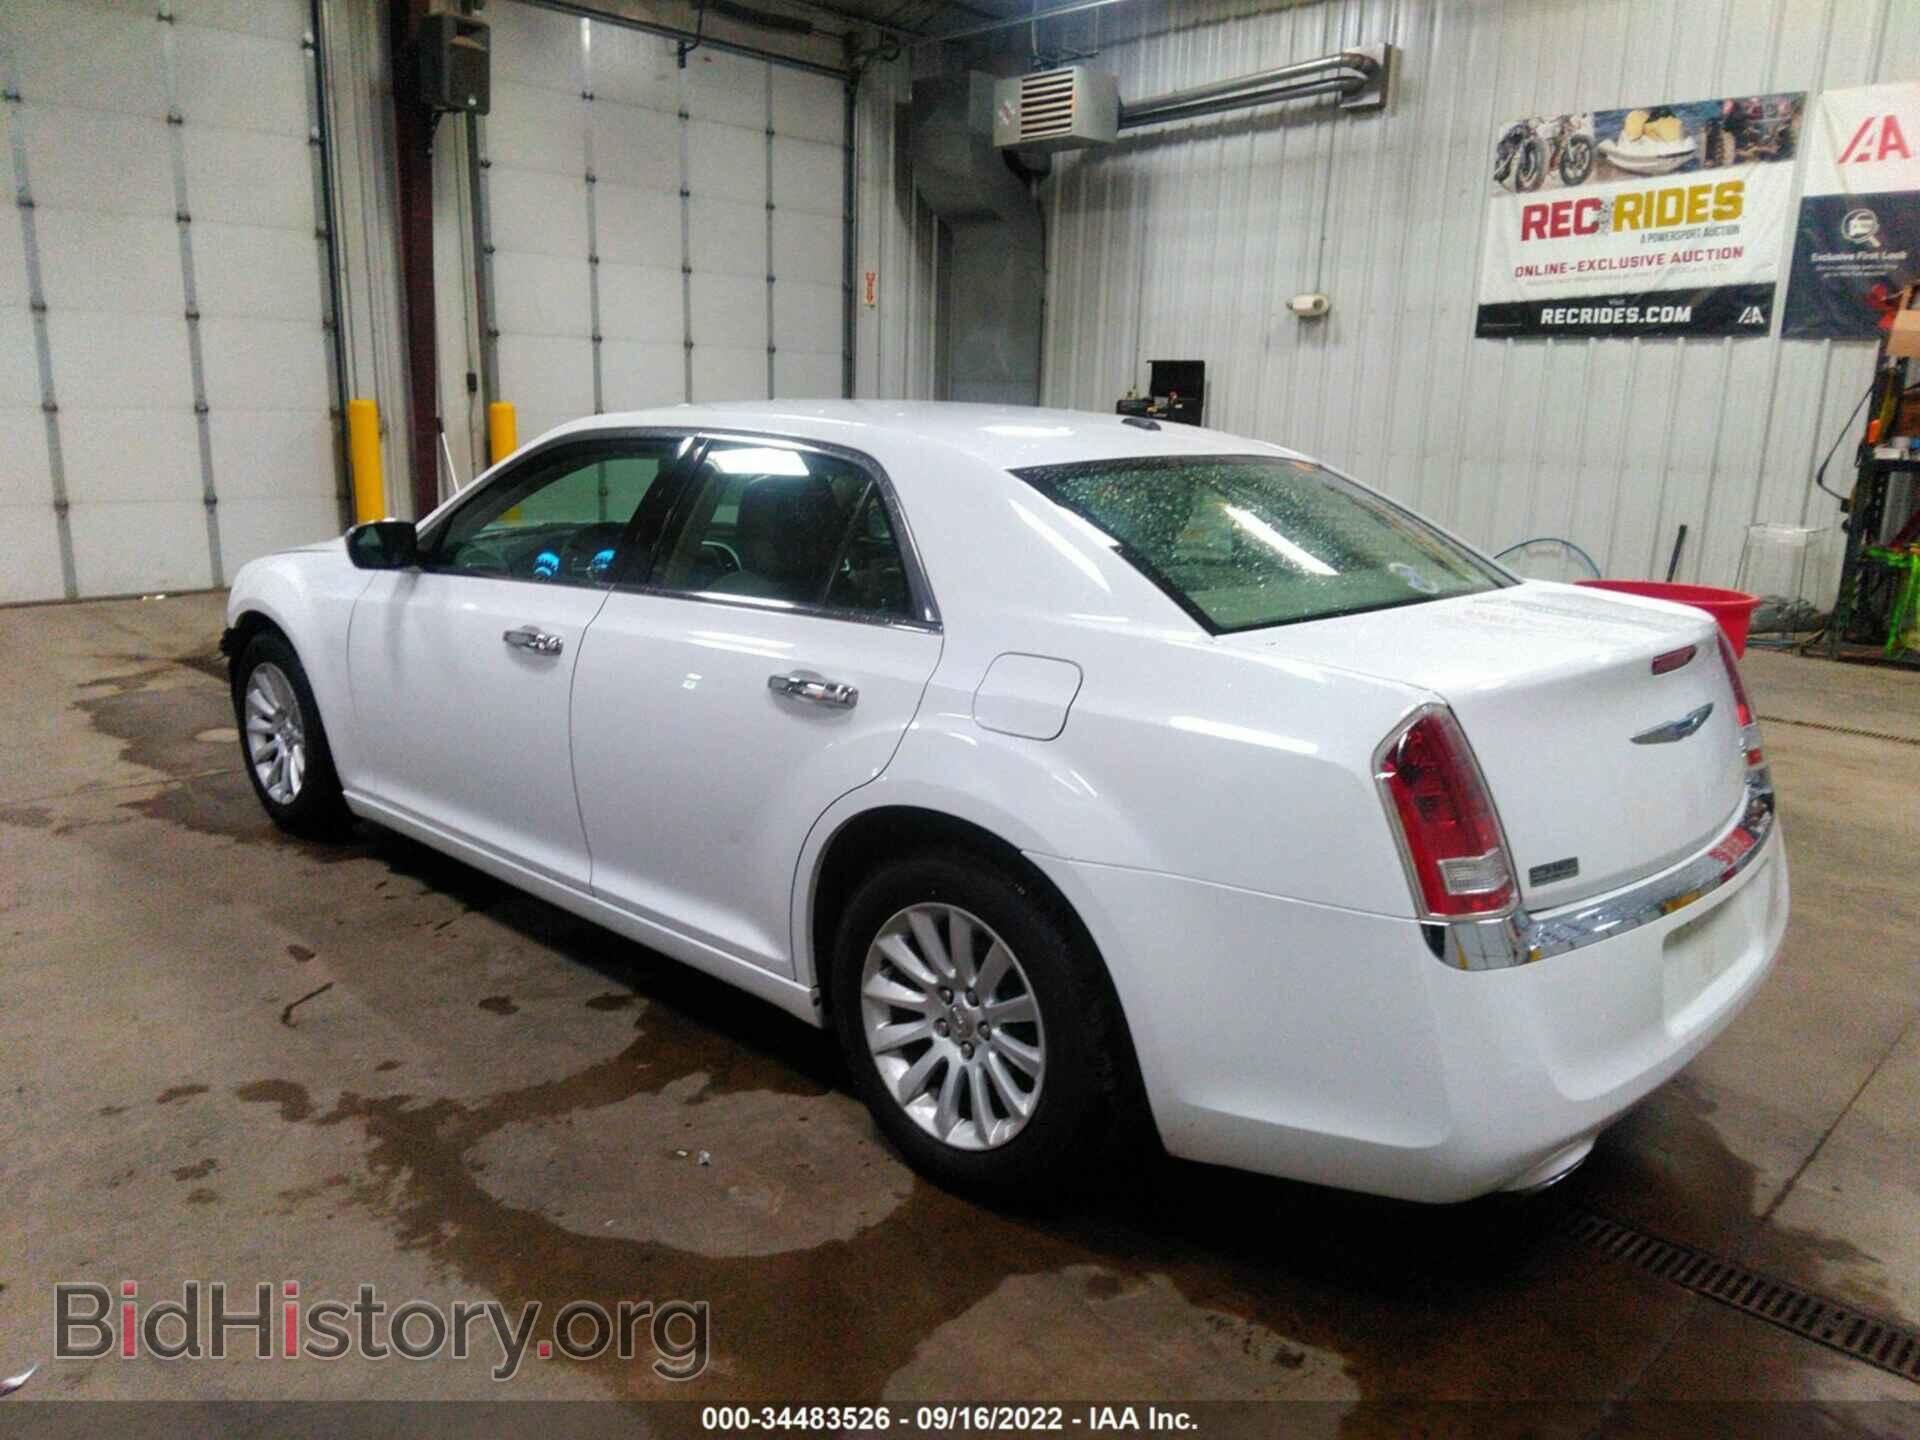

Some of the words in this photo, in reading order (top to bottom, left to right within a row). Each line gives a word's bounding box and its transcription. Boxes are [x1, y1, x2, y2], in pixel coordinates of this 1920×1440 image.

[1521, 197, 1602, 242] REC
[1612, 180, 1744, 233] RIDES
[1703, 224, 1740, 237] AUCTION
[1515, 253, 1664, 278] ONLINE-EXCLUSIVE
[1670, 246, 1743, 264] AUCTION
[1540, 305, 1692, 325] RECRIDES.COM
